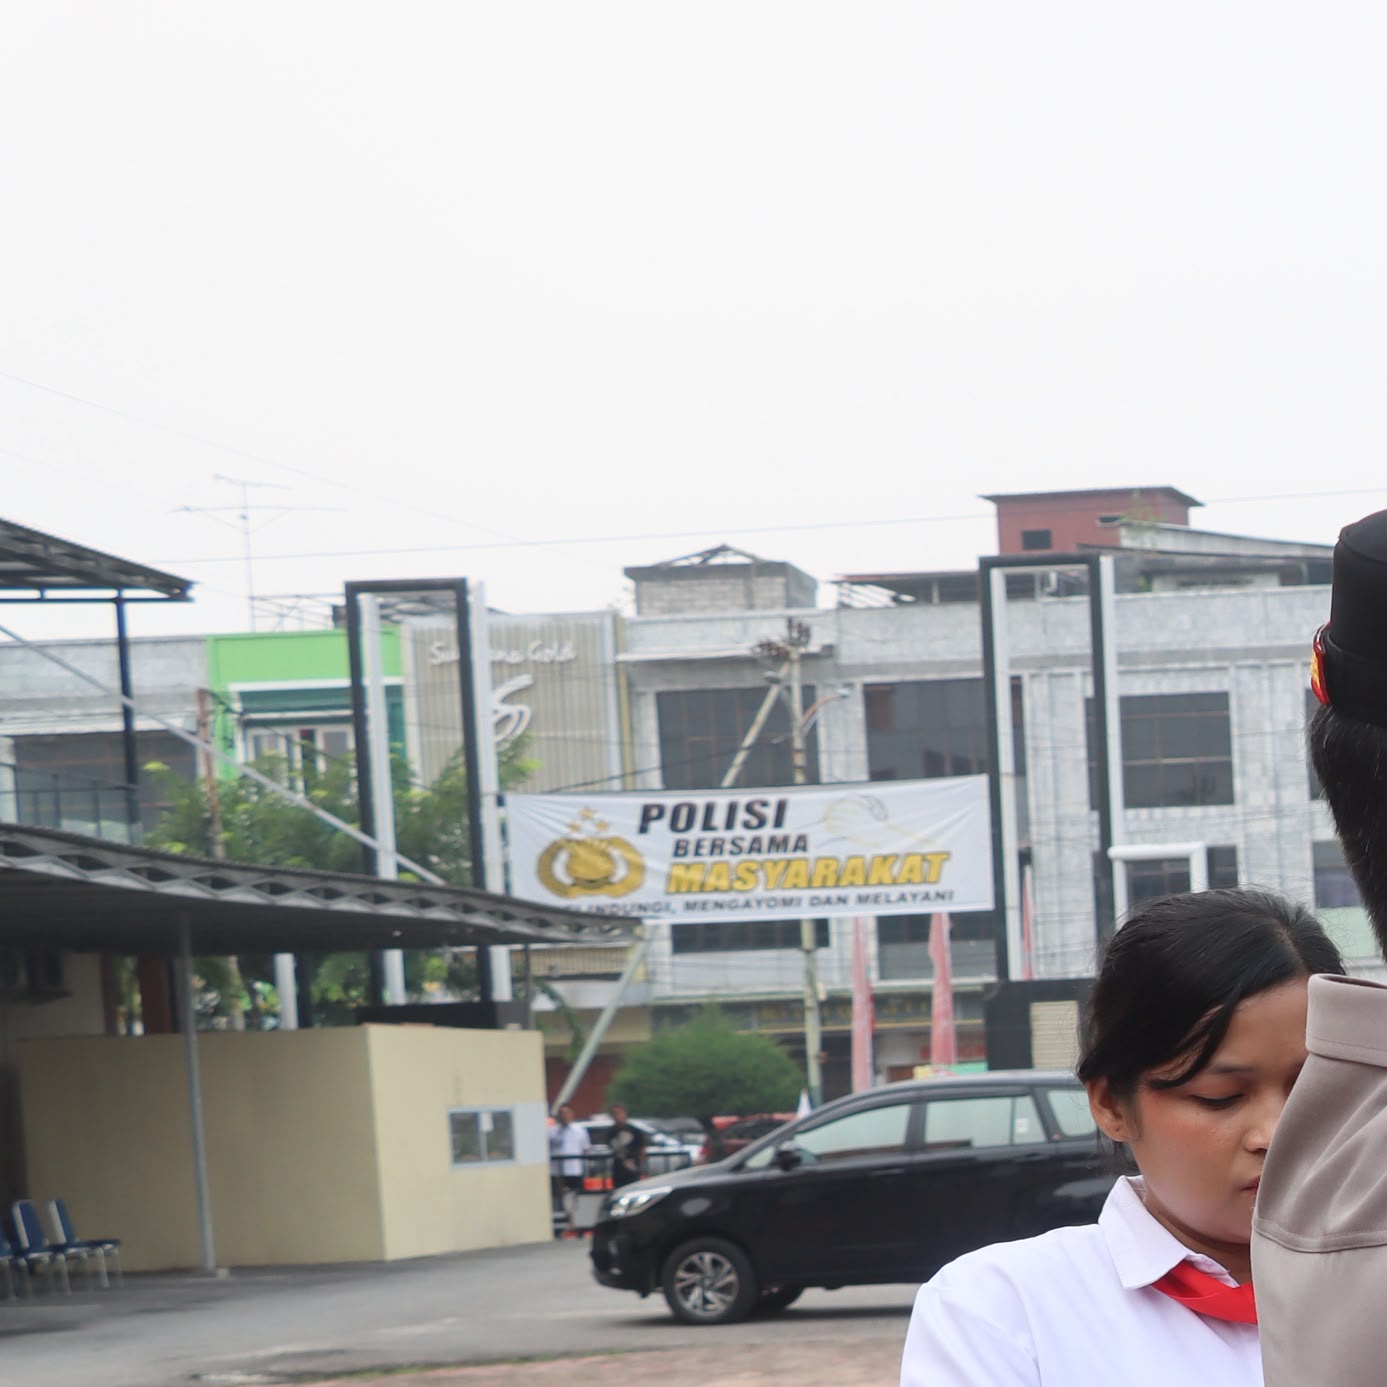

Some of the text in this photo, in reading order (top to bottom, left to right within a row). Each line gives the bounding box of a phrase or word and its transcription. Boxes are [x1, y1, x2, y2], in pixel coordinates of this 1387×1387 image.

[638, 799, 790, 834] POLISI
[673, 834, 808, 858] BERSAMA
[666, 852, 951, 895] MASYARAKAT
[683, 897, 803, 915] MENGAYOMI
[809, 895, 850, 907] DAN
[855, 890, 954, 905] MELAYANI
